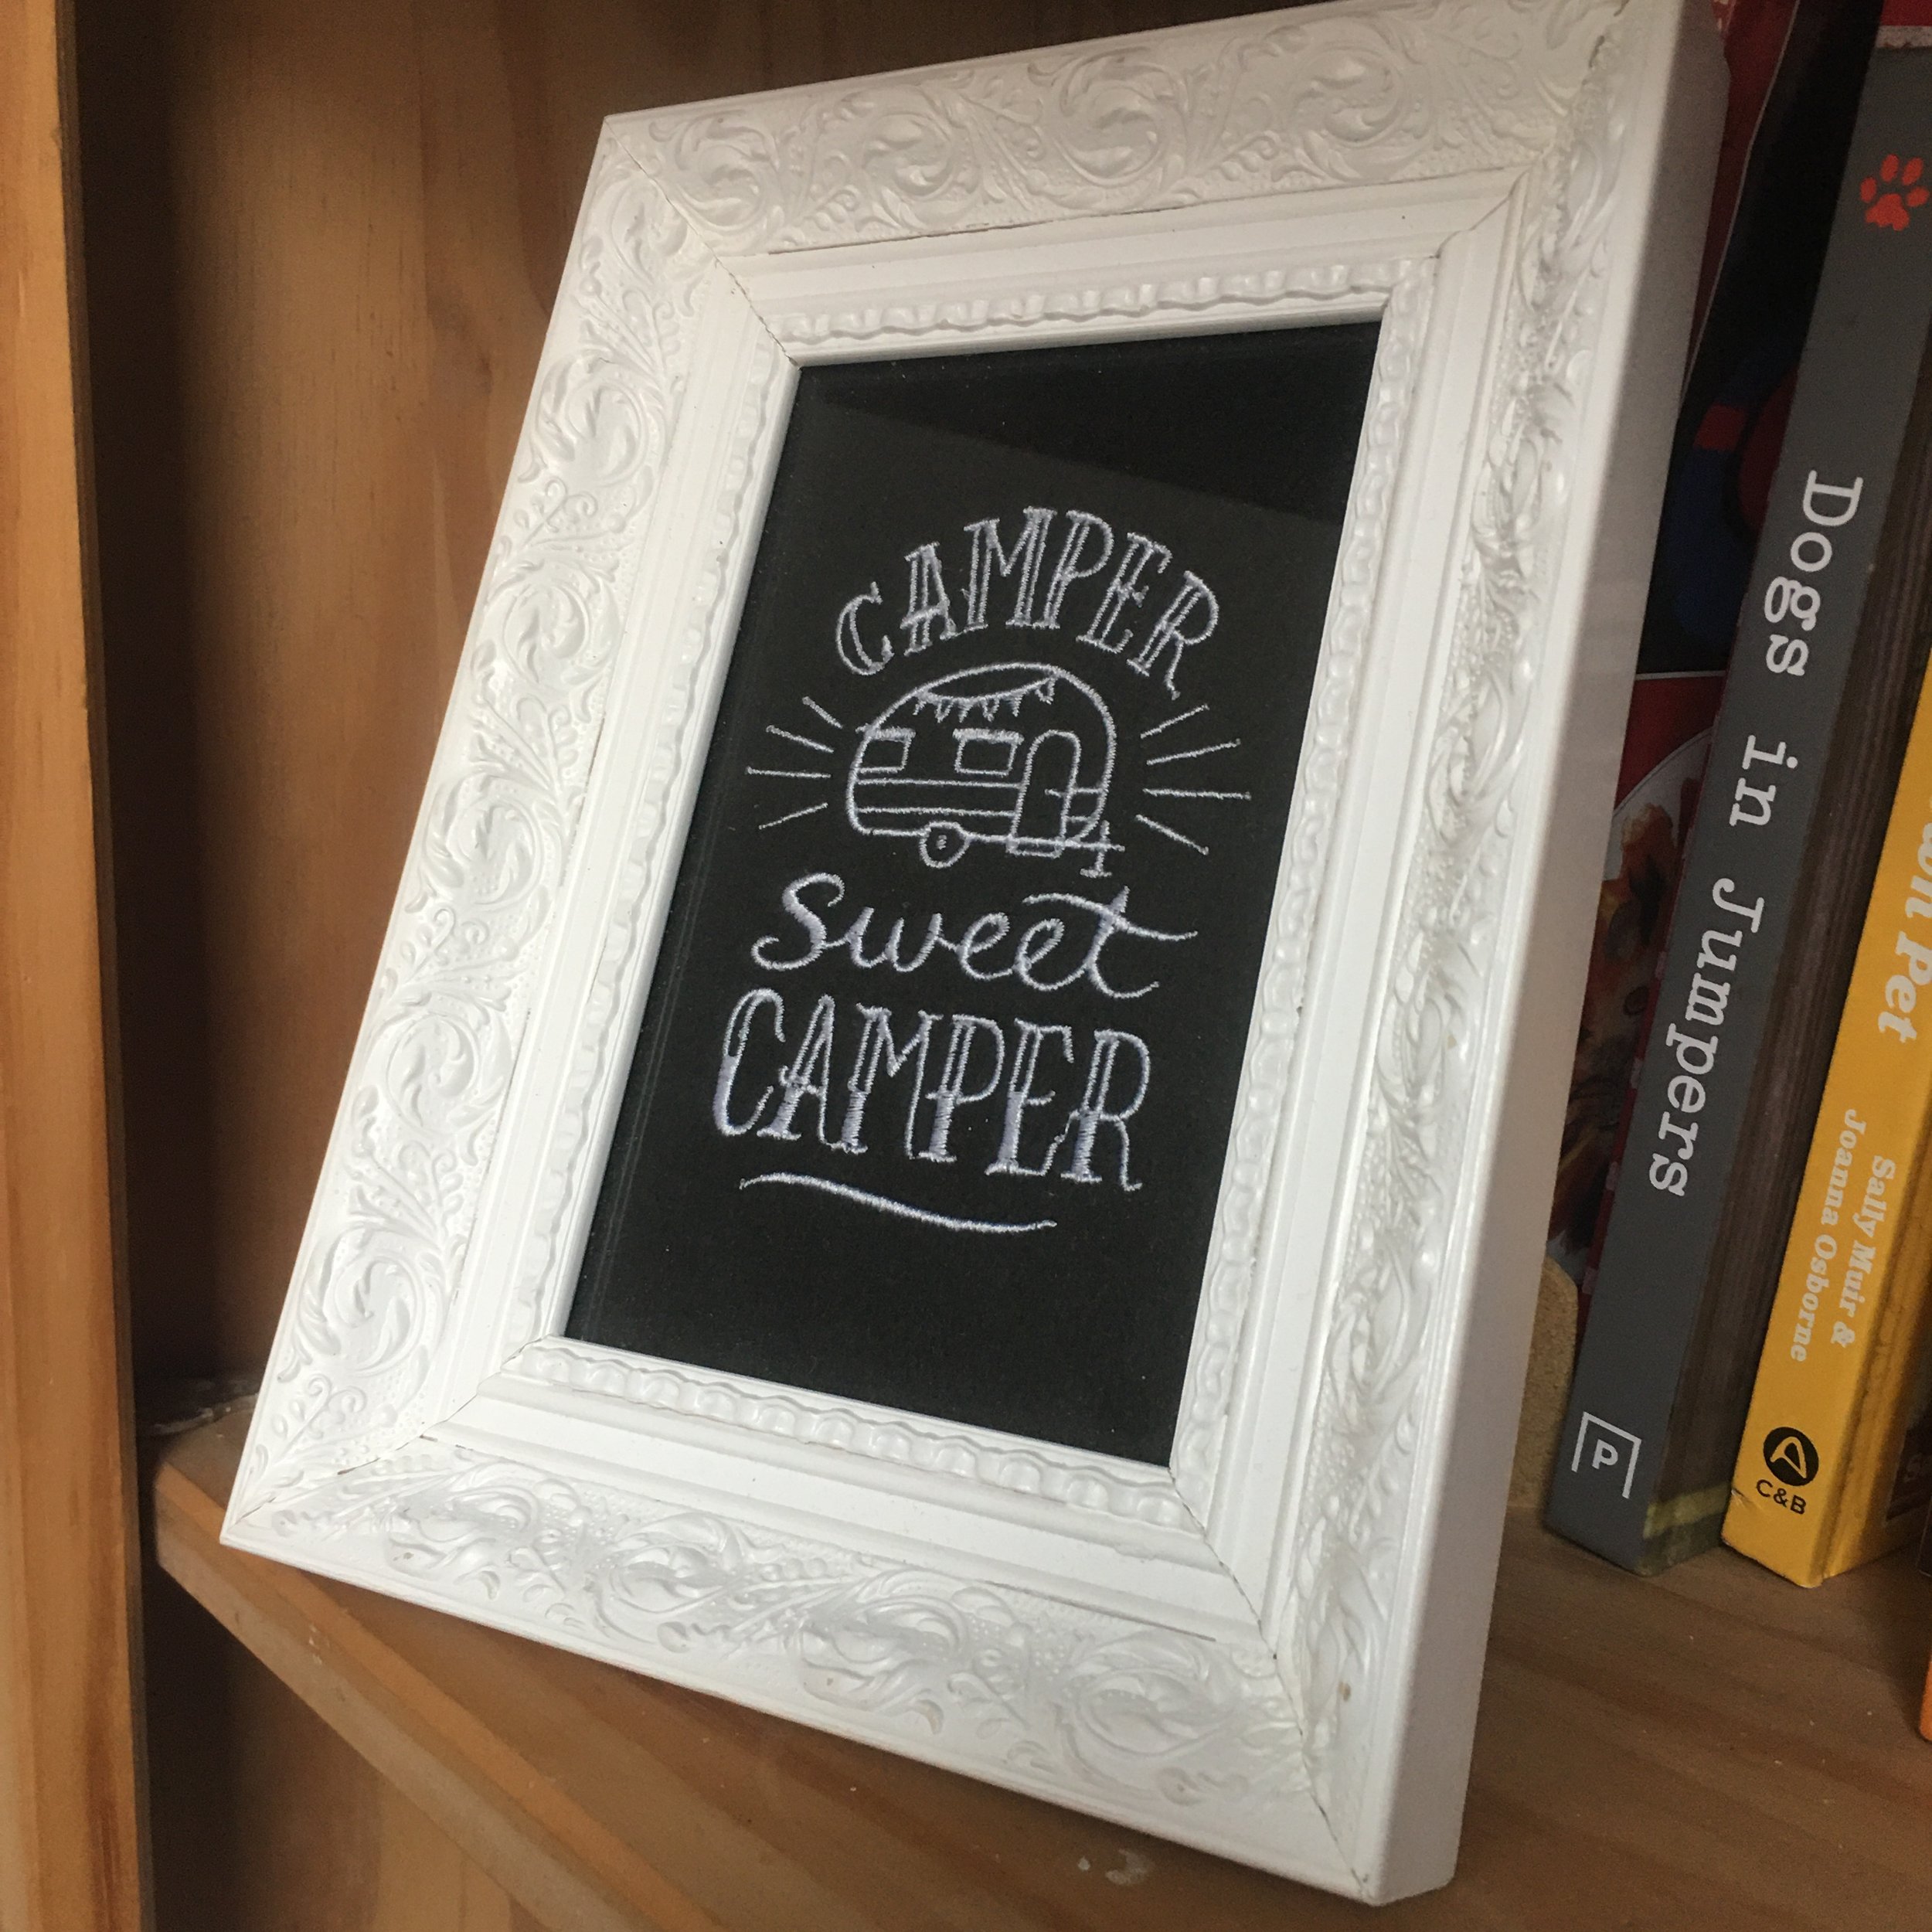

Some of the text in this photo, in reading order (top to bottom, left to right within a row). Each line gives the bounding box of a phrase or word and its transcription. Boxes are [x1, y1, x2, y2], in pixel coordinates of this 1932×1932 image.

[835, 505, 1219, 700] CAMPER
[1648, 470, 1863, 1198] Dogs in Jumpers
[1878, 930, 1932, 1043] Pet
[713, 988, 1151, 1192] CAMPER
[1790, 1108, 1867, 1362] Joanna Osborne
[1830, 1155, 1896, 1348] Sally Muir &
[1755, 1478, 1807, 1515] C&B
